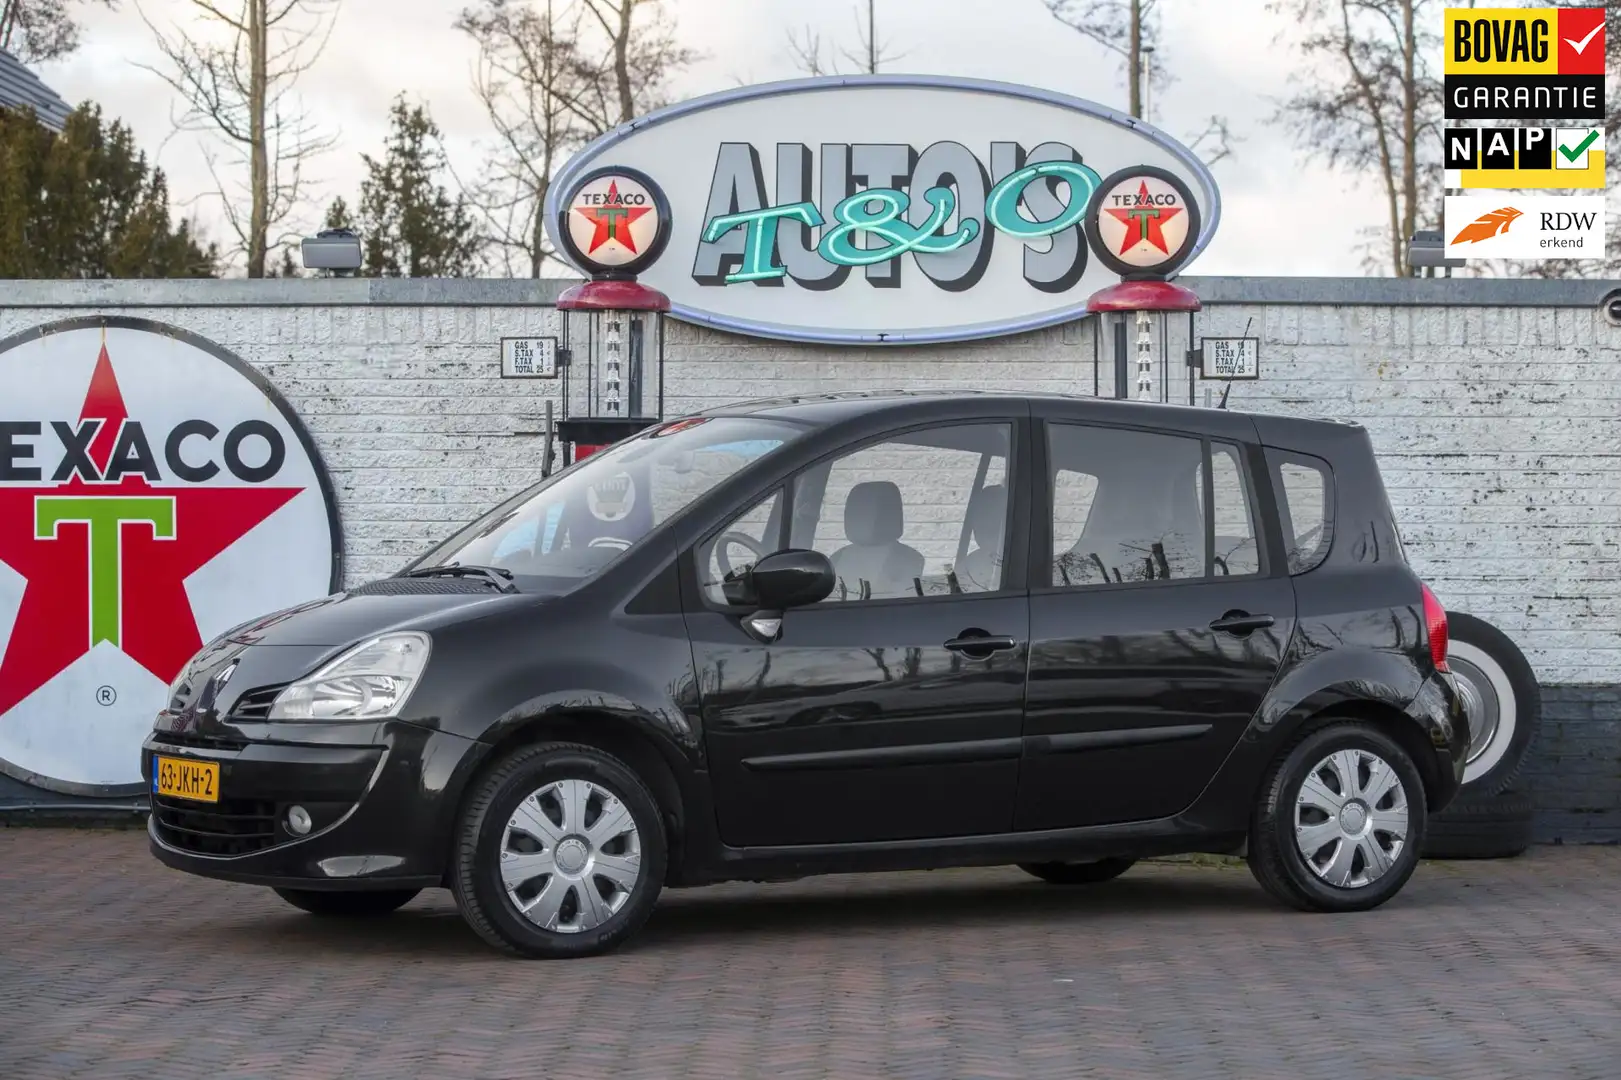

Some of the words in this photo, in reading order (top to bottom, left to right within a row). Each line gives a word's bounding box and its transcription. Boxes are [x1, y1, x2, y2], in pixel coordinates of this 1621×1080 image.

[582, 194, 646, 205] TEXACO
[1112, 194, 1176, 206] TEXACO
[514, 341, 529, 349] GAS
[1215, 341, 1230, 349] GAS
[536, 365, 544, 373] 25
[1237, 365, 1246, 373] 25
[0, 419, 286, 483] EXACO
[161, 762, 213, 796] 63-JKH-2
